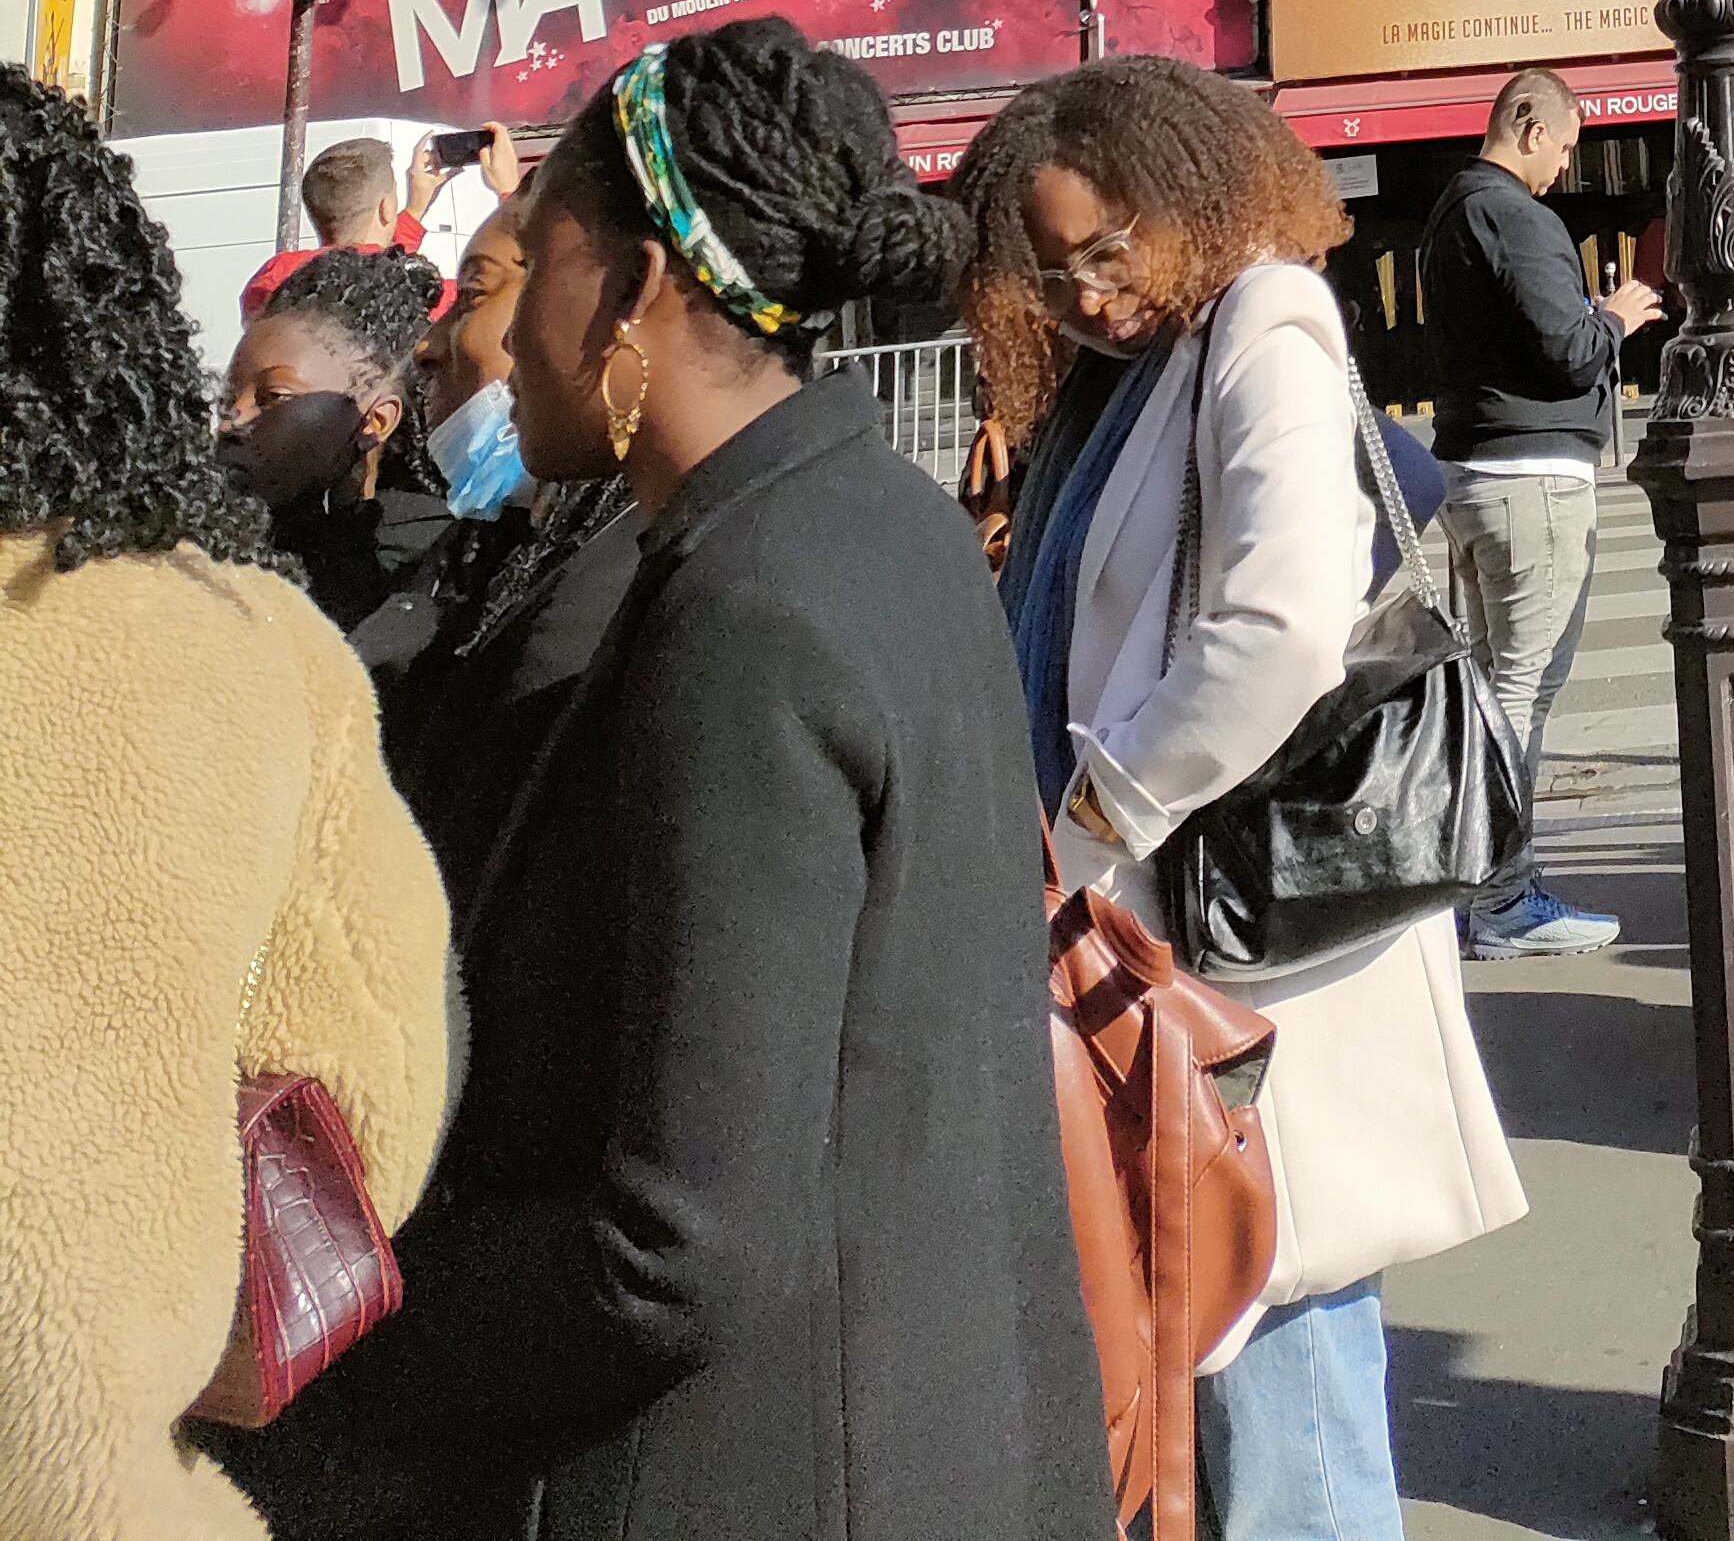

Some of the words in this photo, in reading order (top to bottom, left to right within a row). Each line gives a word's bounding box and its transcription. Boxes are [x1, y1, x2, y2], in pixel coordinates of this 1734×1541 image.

[646, 5, 669, 25] DU
[1382, 24, 1400, 45] LA
[1407, 20, 1456, 43] MAGIE
[1564, 11, 1592, 31] THE
[1599, 6, 1648, 29] MAGIC
[936, 27, 995, 53] CLUB
[1607, 93, 1678, 115] ROUGE
